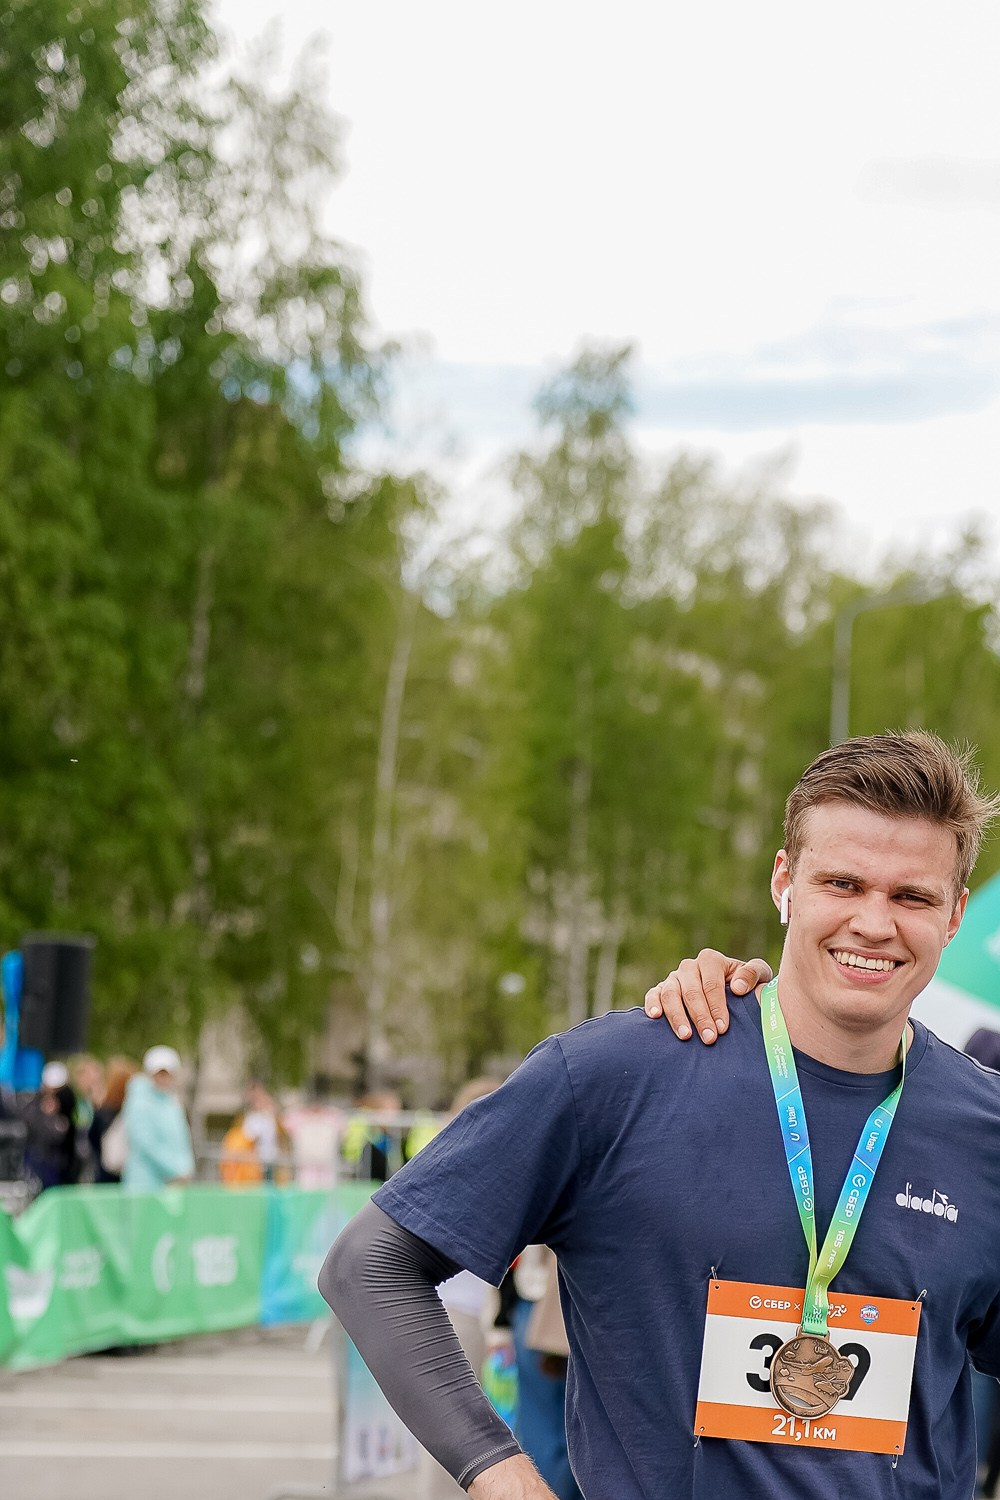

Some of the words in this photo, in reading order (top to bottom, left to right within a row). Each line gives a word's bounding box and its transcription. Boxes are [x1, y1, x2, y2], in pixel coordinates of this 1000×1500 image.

[787, 1105, 799, 1127] Utair
[866, 1131, 880, 1153] Utair
[797, 1165, 810, 1196] СБЕР
[844, 1188, 860, 1218] СБЕР
[895, 1182, 959, 1223] diadora
[834, 1229, 846, 1249] 185
[826, 1250, 837, 1269] лет
[763, 1299, 791, 1310] СБЕР
[746, 1333, 871, 1401] 39
[771, 1414, 811, 1441] 21,1
